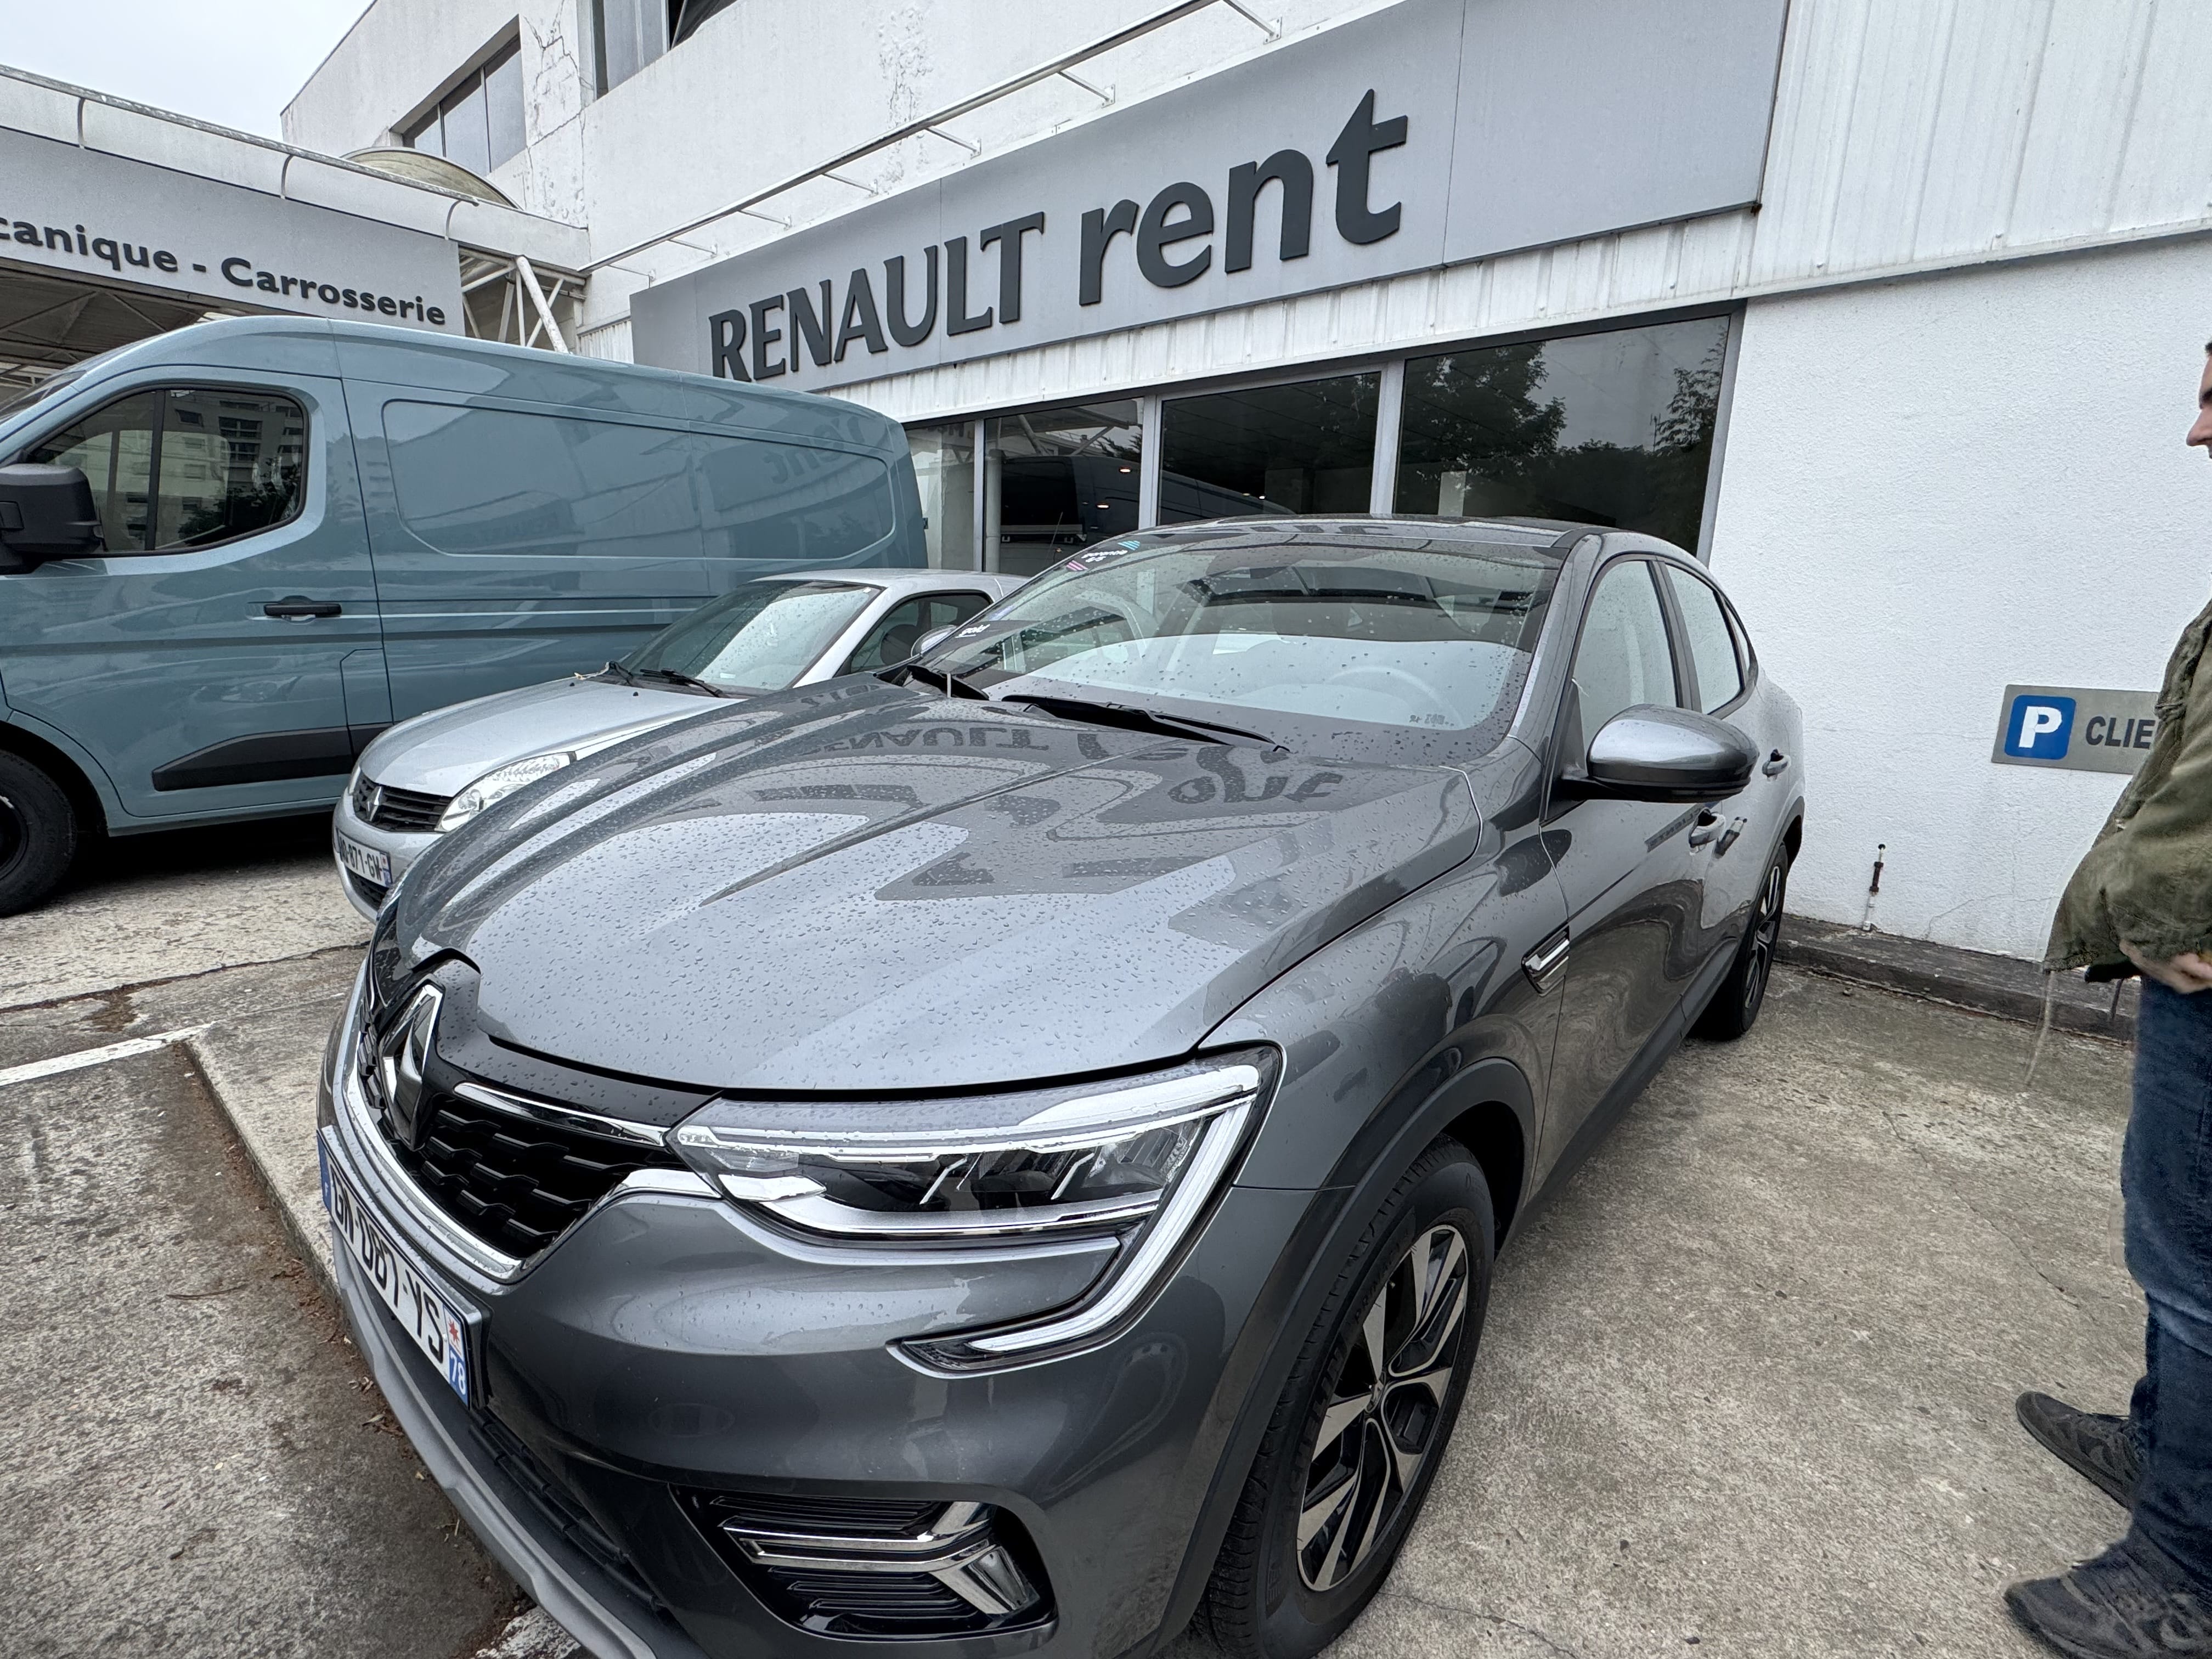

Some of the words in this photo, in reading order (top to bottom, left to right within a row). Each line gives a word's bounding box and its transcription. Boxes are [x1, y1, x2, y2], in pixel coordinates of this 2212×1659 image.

[709, 211, 1044, 382] RENAULT
[1079, 88, 1408, 306] rent
[221, 257, 445, 325] Carrosserie
[2018, 706, 2062, 748] P
[2086, 716, 2155, 749] CLIE
[450, 1350, 466, 1395] 78
